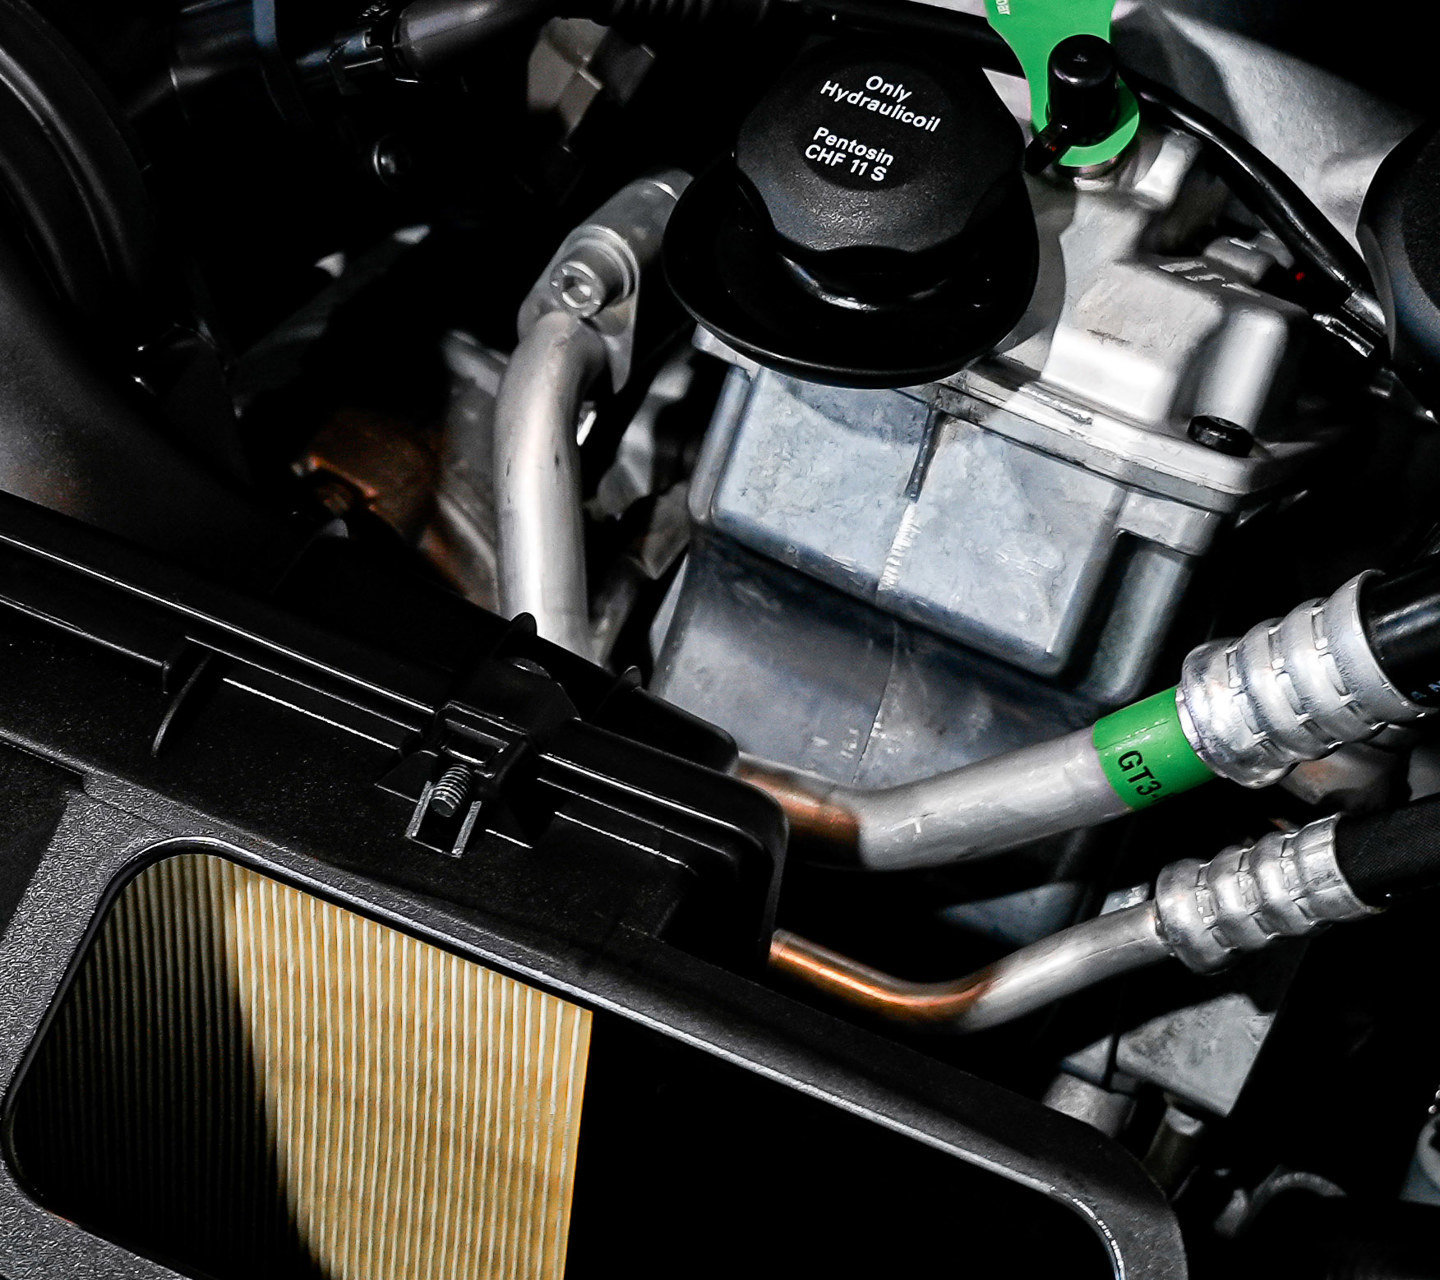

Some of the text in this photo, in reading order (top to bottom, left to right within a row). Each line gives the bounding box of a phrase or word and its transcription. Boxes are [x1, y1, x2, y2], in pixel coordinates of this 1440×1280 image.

[820, 80, 941, 132] Hydraulicoil
[865, 75, 912, 103] Only
[804, 144, 887, 181] CHF 11 S
[813, 126, 894, 166] Pentosin
